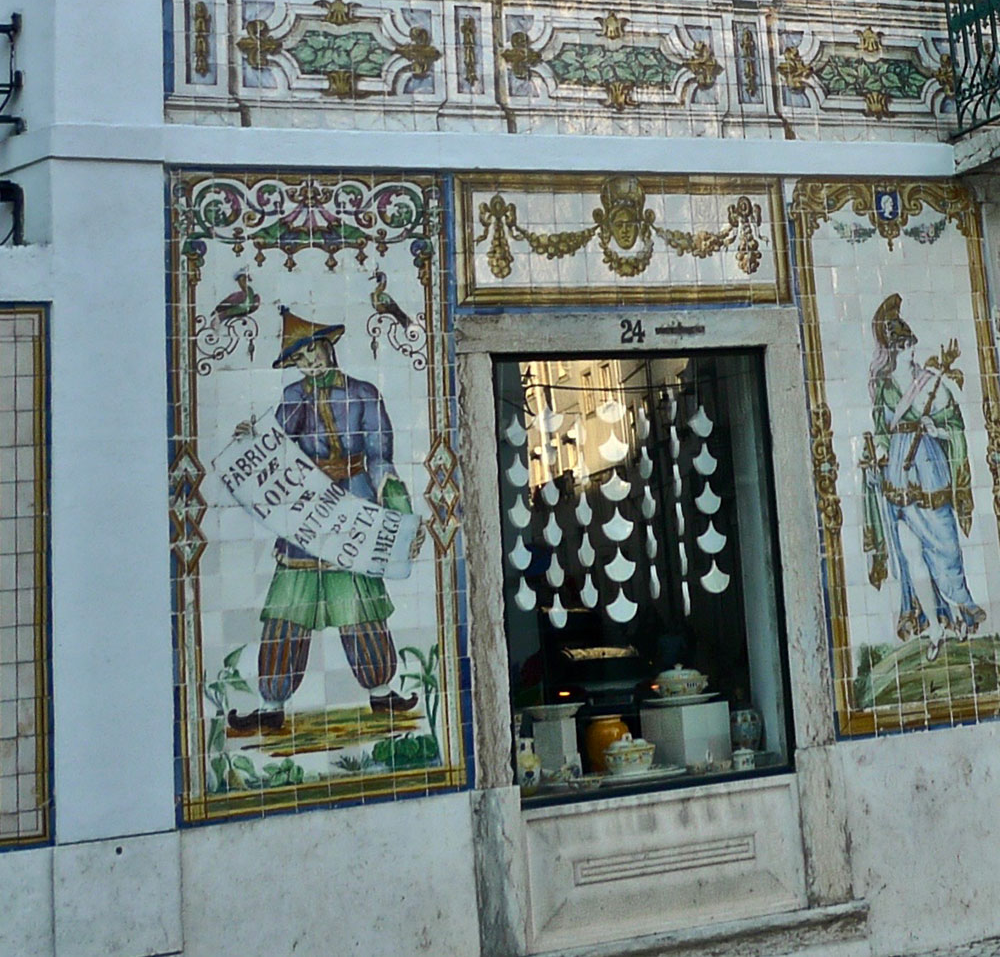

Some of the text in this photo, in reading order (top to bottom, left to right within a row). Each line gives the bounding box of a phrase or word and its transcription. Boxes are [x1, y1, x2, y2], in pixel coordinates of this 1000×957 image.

[620, 319, 646, 343] 24
[253, 457, 315, 520] LOIÇA
[256, 457, 280, 487] DE
[290, 489, 316, 513] DE
[336, 504, 380, 570] COSTA
[366, 510, 401, 577] LAMEGO
